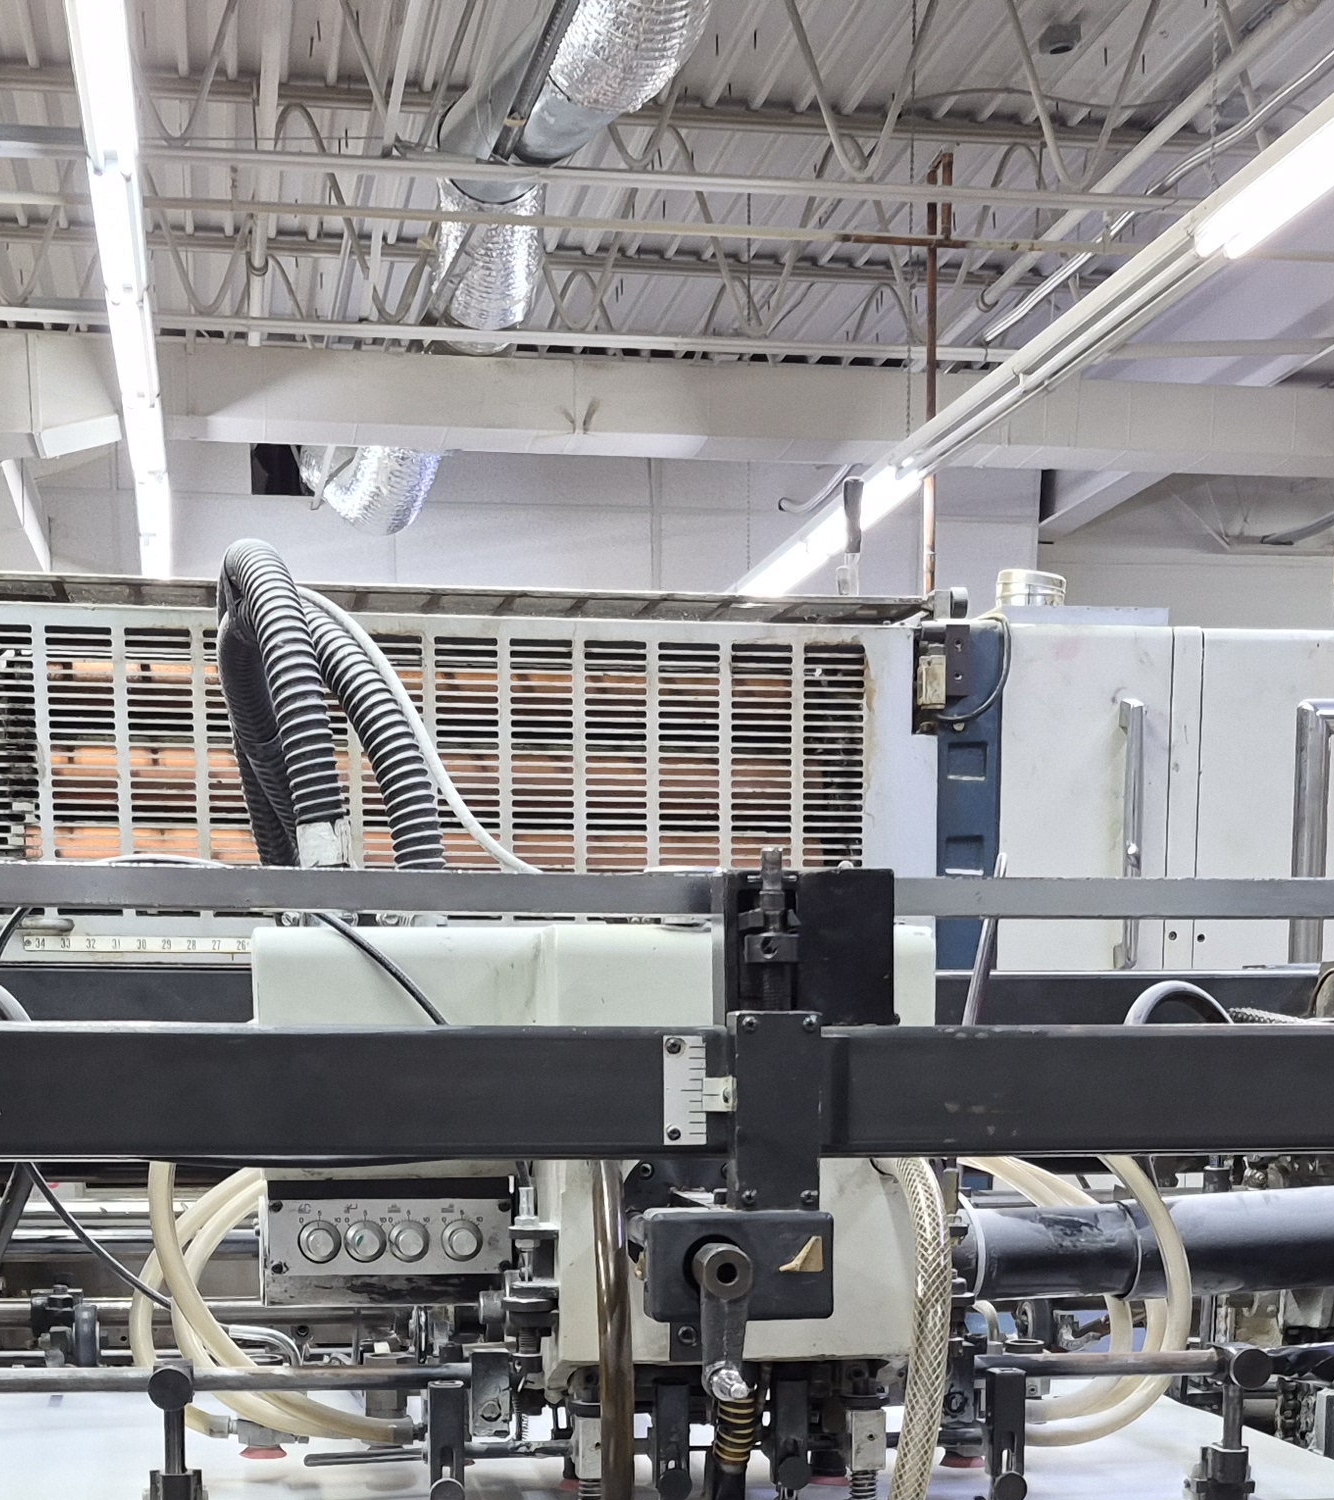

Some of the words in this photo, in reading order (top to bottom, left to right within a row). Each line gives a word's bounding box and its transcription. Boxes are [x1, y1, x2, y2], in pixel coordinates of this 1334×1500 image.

[35, 938, 45, 948] 34
[61, 938, 70, 948] 33
[86, 938, 96, 949] 32
[112, 938, 121, 949] 31
[137, 939, 147, 949] 30
[162, 939, 171, 949] 29
[187, 940, 196, 950] 28
[212, 940, 221, 950] 27
[236, 940, 246, 950] 26
